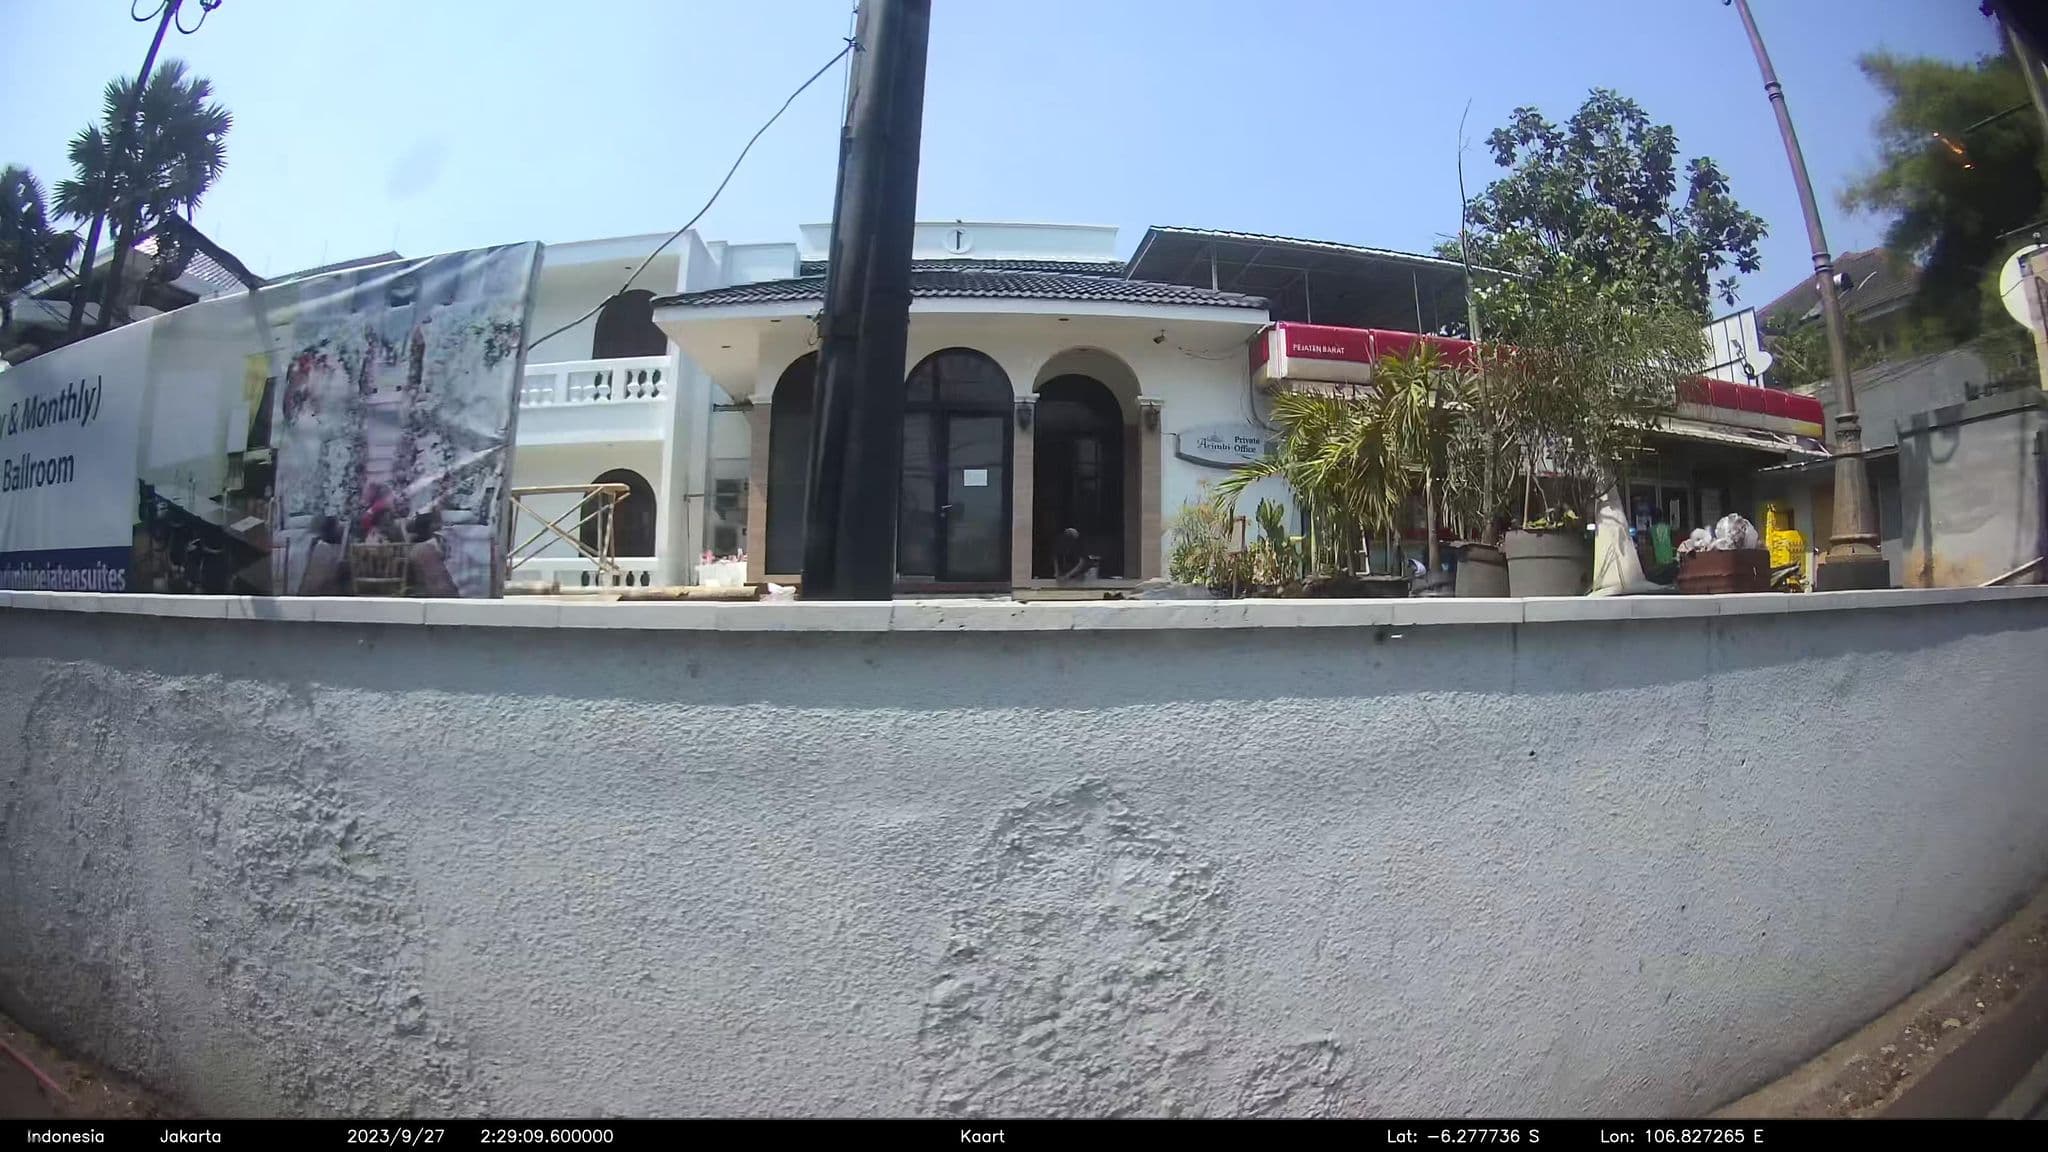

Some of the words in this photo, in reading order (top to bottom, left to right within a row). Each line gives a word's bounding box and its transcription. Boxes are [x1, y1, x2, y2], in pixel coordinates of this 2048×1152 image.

[1292, 343, 1322, 353] PEJATEN
[1322, 345, 1345, 354] BARAT
[8, 402, 18, 436] &
[21, 375, 102, 433] Monthly)
[1234, 435, 1260, 445] Private
[1233, 444, 1256, 453] Office
[3, 452, 74, 492] Ballroom
